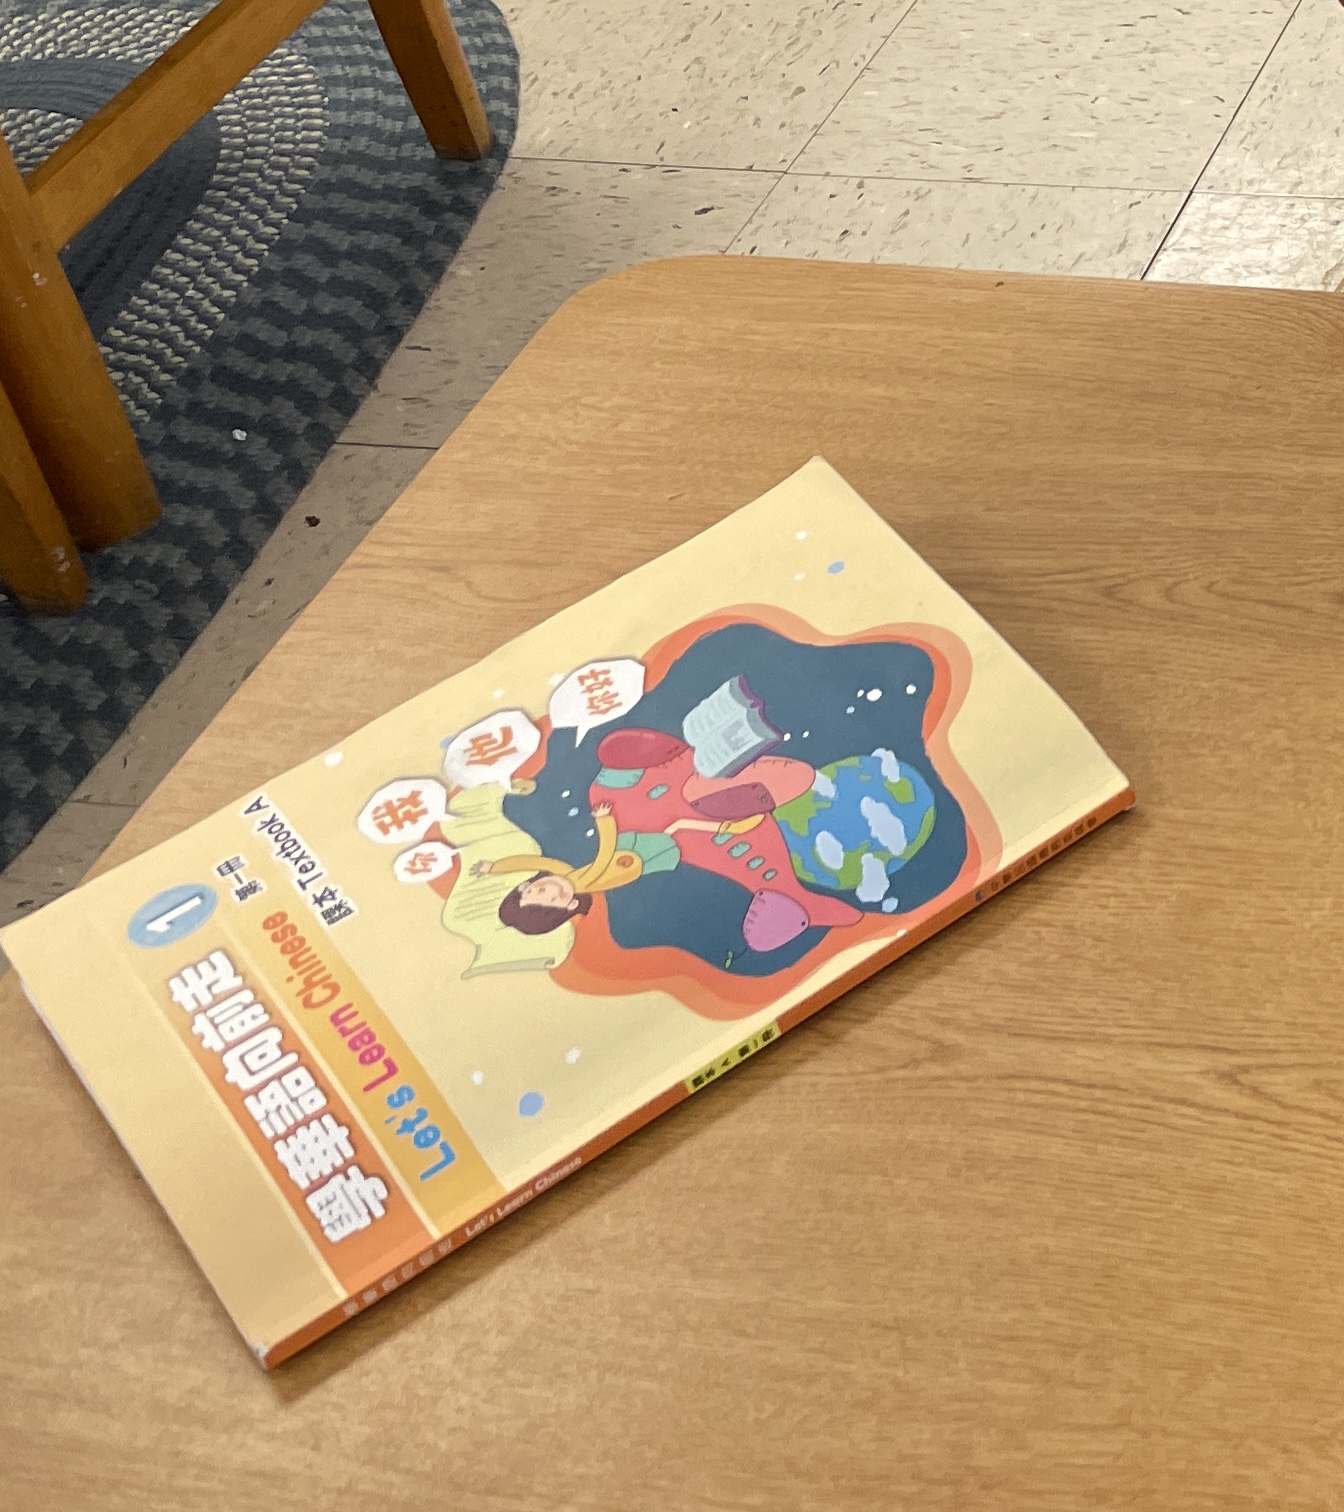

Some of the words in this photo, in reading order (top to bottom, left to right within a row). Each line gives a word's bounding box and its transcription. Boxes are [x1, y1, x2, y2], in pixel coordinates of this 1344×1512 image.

[577, 668, 623, 716] 你好
[464, 725, 518, 767] 他
[243, 795, 271, 815] A
[371, 790, 428, 837] 我
[258, 812, 326, 893] Textbook
[216, 855, 264, 902] 第一冊
[146, 893, 204, 935] 1
[312, 886, 356, 926] 課本
[261, 910, 343, 1010] Chinese
[329, 1002, 399, 1094] Learn
[168, 948, 391, 1244] 學華語向前走
[383, 1083, 457, 1182] Let's
[534, 1157, 582, 1190] Chinese
